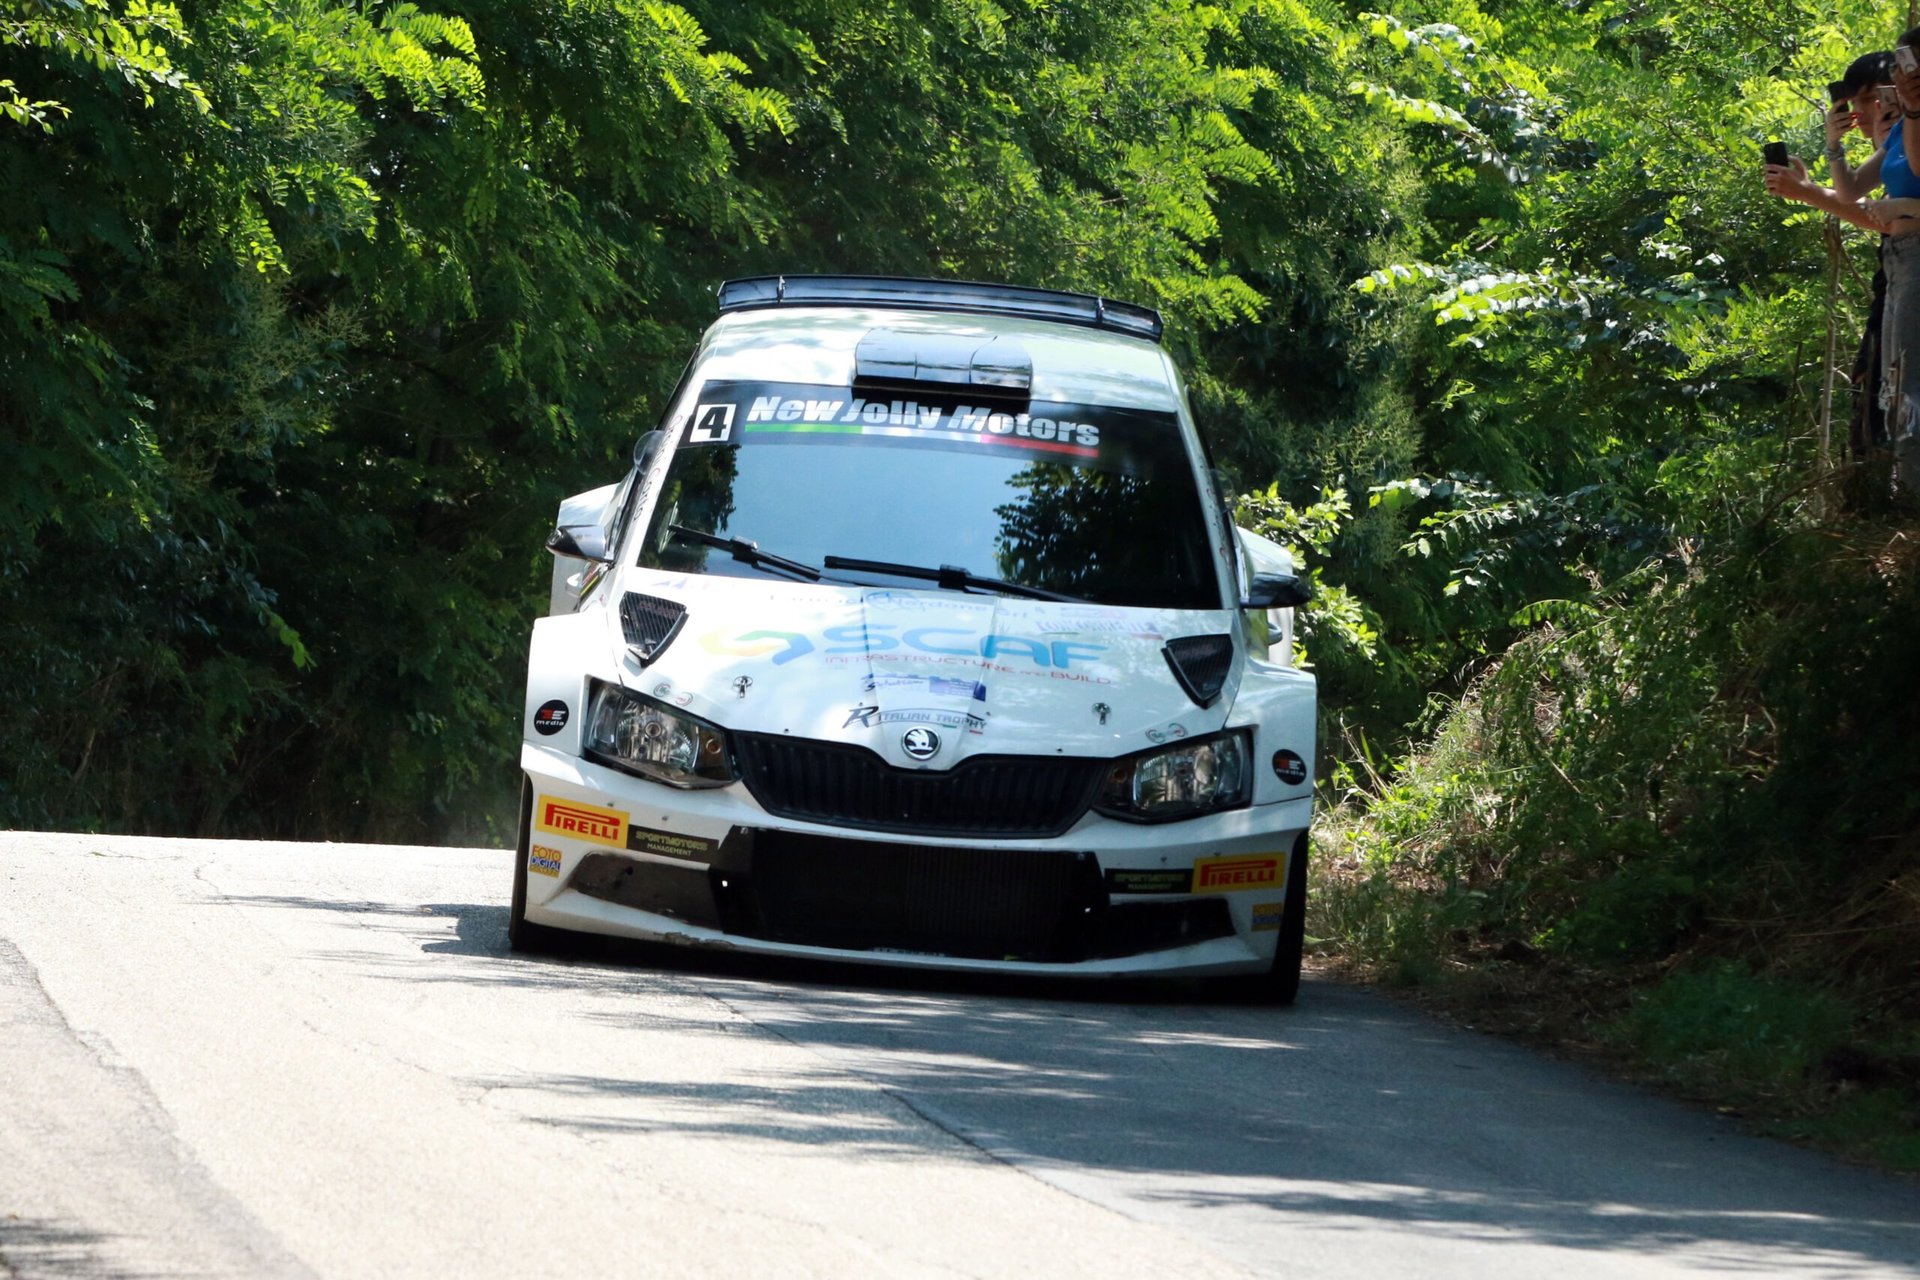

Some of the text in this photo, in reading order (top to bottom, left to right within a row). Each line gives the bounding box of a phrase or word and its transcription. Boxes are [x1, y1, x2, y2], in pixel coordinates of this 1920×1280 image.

[700, 407, 727, 438] 4
[748, 396, 1100, 446] New Jolly Motors
[825, 624, 1108, 669] SCAF
[825, 654, 1014, 674] INFRASTRUCTURE
[1051, 670, 1111, 685] BUILD
[878, 711, 931, 723] ITALIAN
[937, 713, 987, 729] TROPHY
[544, 803, 621, 840] PIRELLI
[532, 845, 562, 862] FOTO
[636, 831, 709, 851] SPORTMOTORS
[647, 843, 692, 857] MANAGEMENT
[530, 857, 561, 871] DIGITAL
[1200, 859, 1278, 887] PIRELLI
